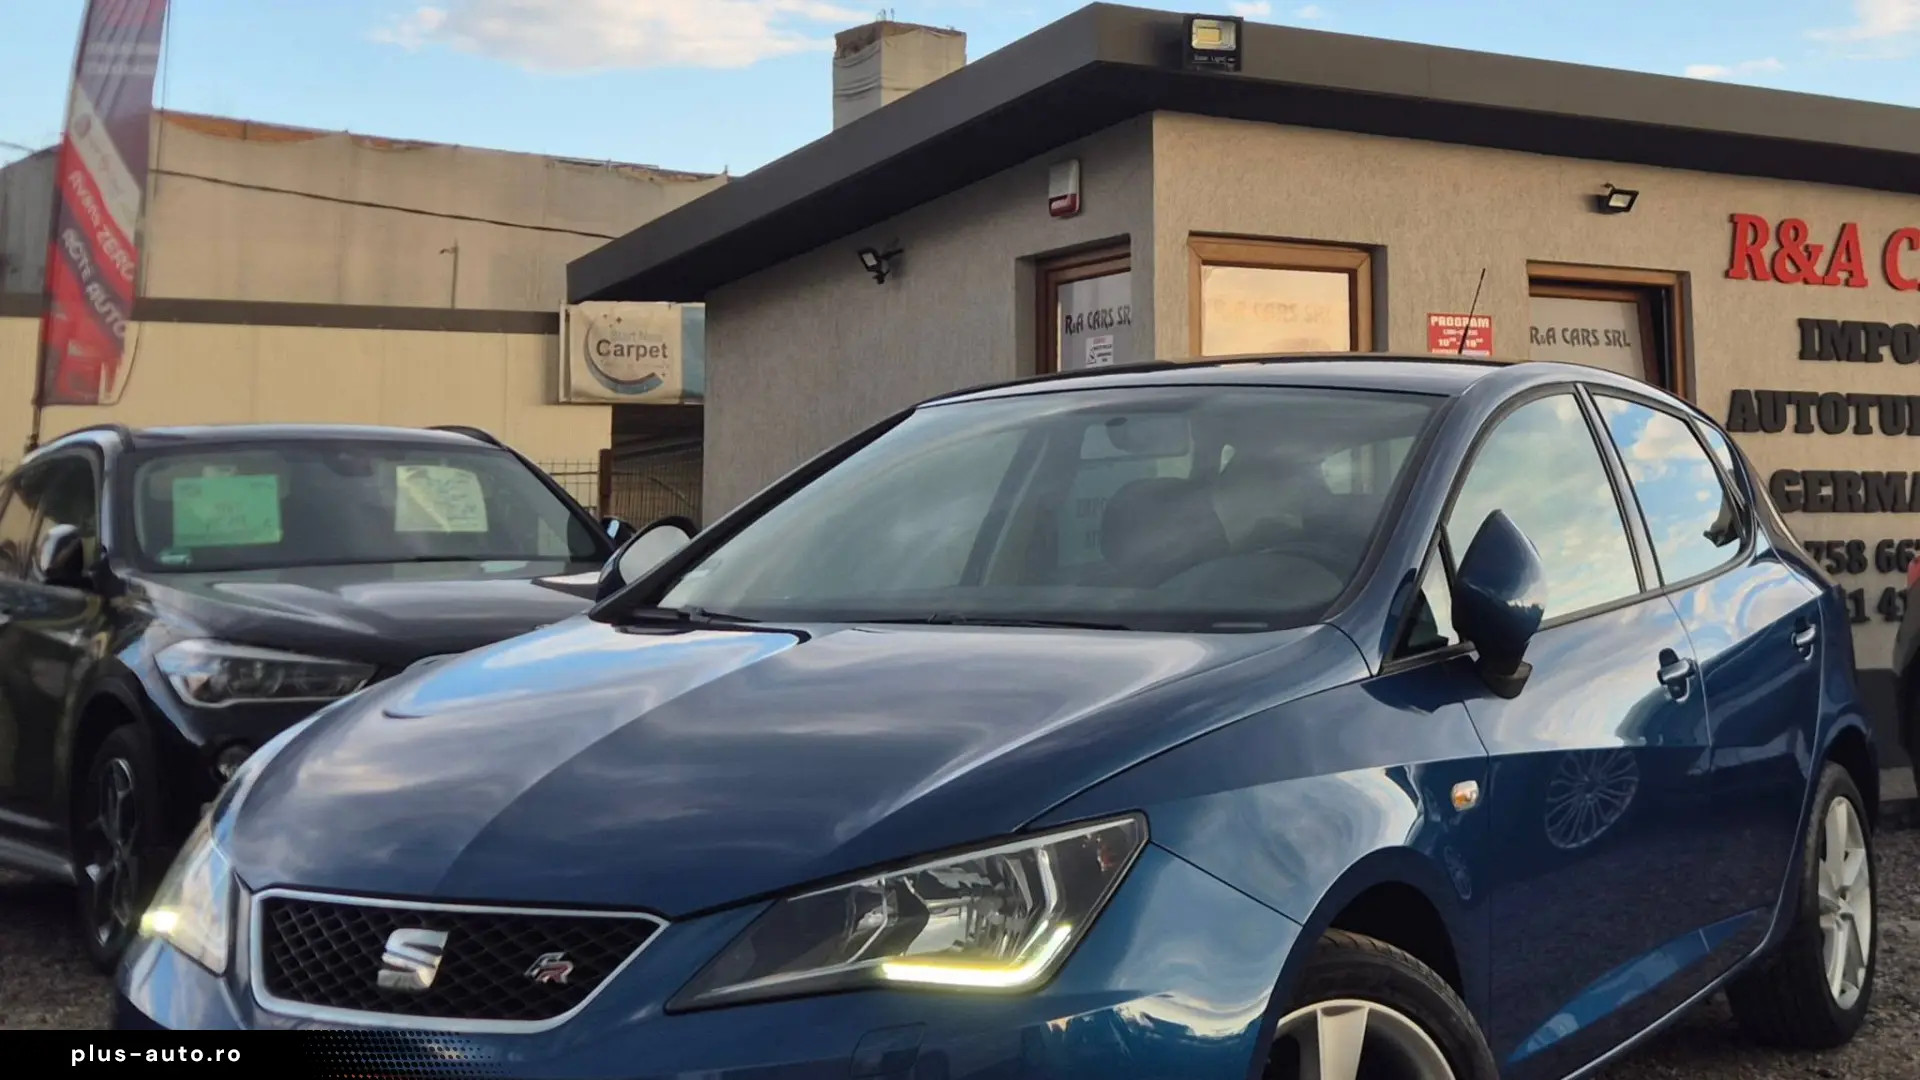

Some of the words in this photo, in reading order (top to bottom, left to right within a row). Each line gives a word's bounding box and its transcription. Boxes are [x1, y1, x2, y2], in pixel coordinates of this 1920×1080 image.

[1724, 213, 1868, 288] R&A
[1882, 227, 1920, 291] C
[1087, 307, 1114, 331] CARS
[1430, 315, 1490, 329] PROGRAM
[596, 338, 668, 361] Carpet
[1561, 327, 1600, 348] CARS
[1604, 329, 1632, 348] SRL
[1797, 317, 1920, 365] IMPO
[1875, 538, 1920, 574] 66
[1846, 587, 1871, 624] 1
